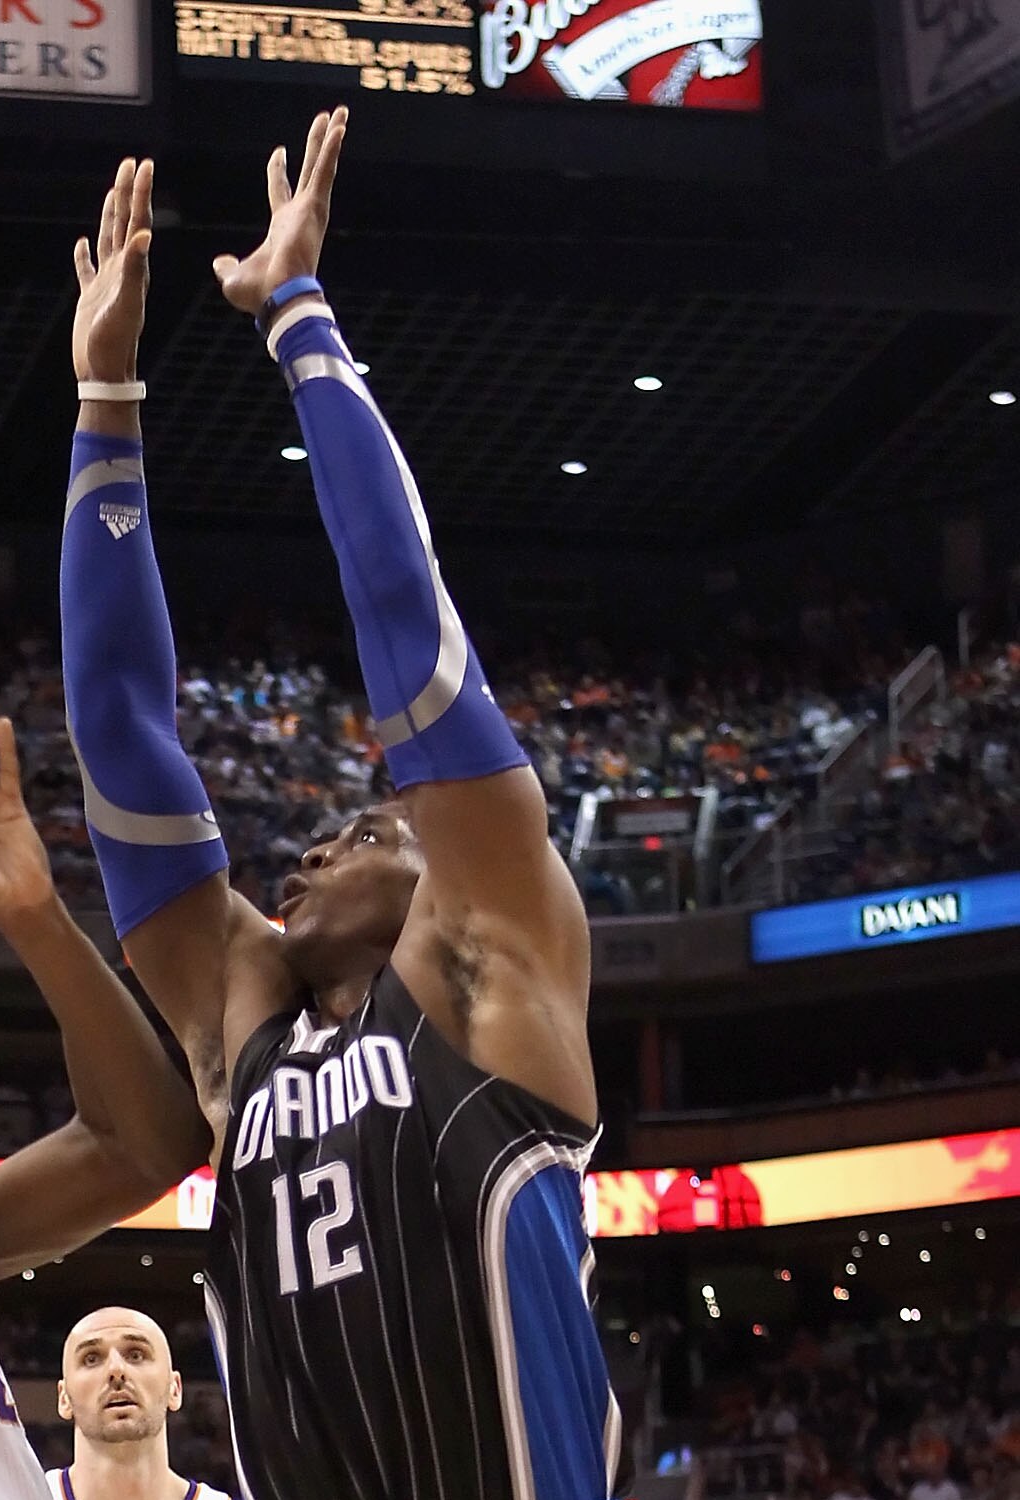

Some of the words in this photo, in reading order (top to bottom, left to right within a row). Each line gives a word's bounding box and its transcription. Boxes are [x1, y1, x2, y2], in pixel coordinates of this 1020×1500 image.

[360, 67, 474, 95] 51.5%
[862, 893, 958, 938] DASANI
[272, 1160, 363, 1296] 12
